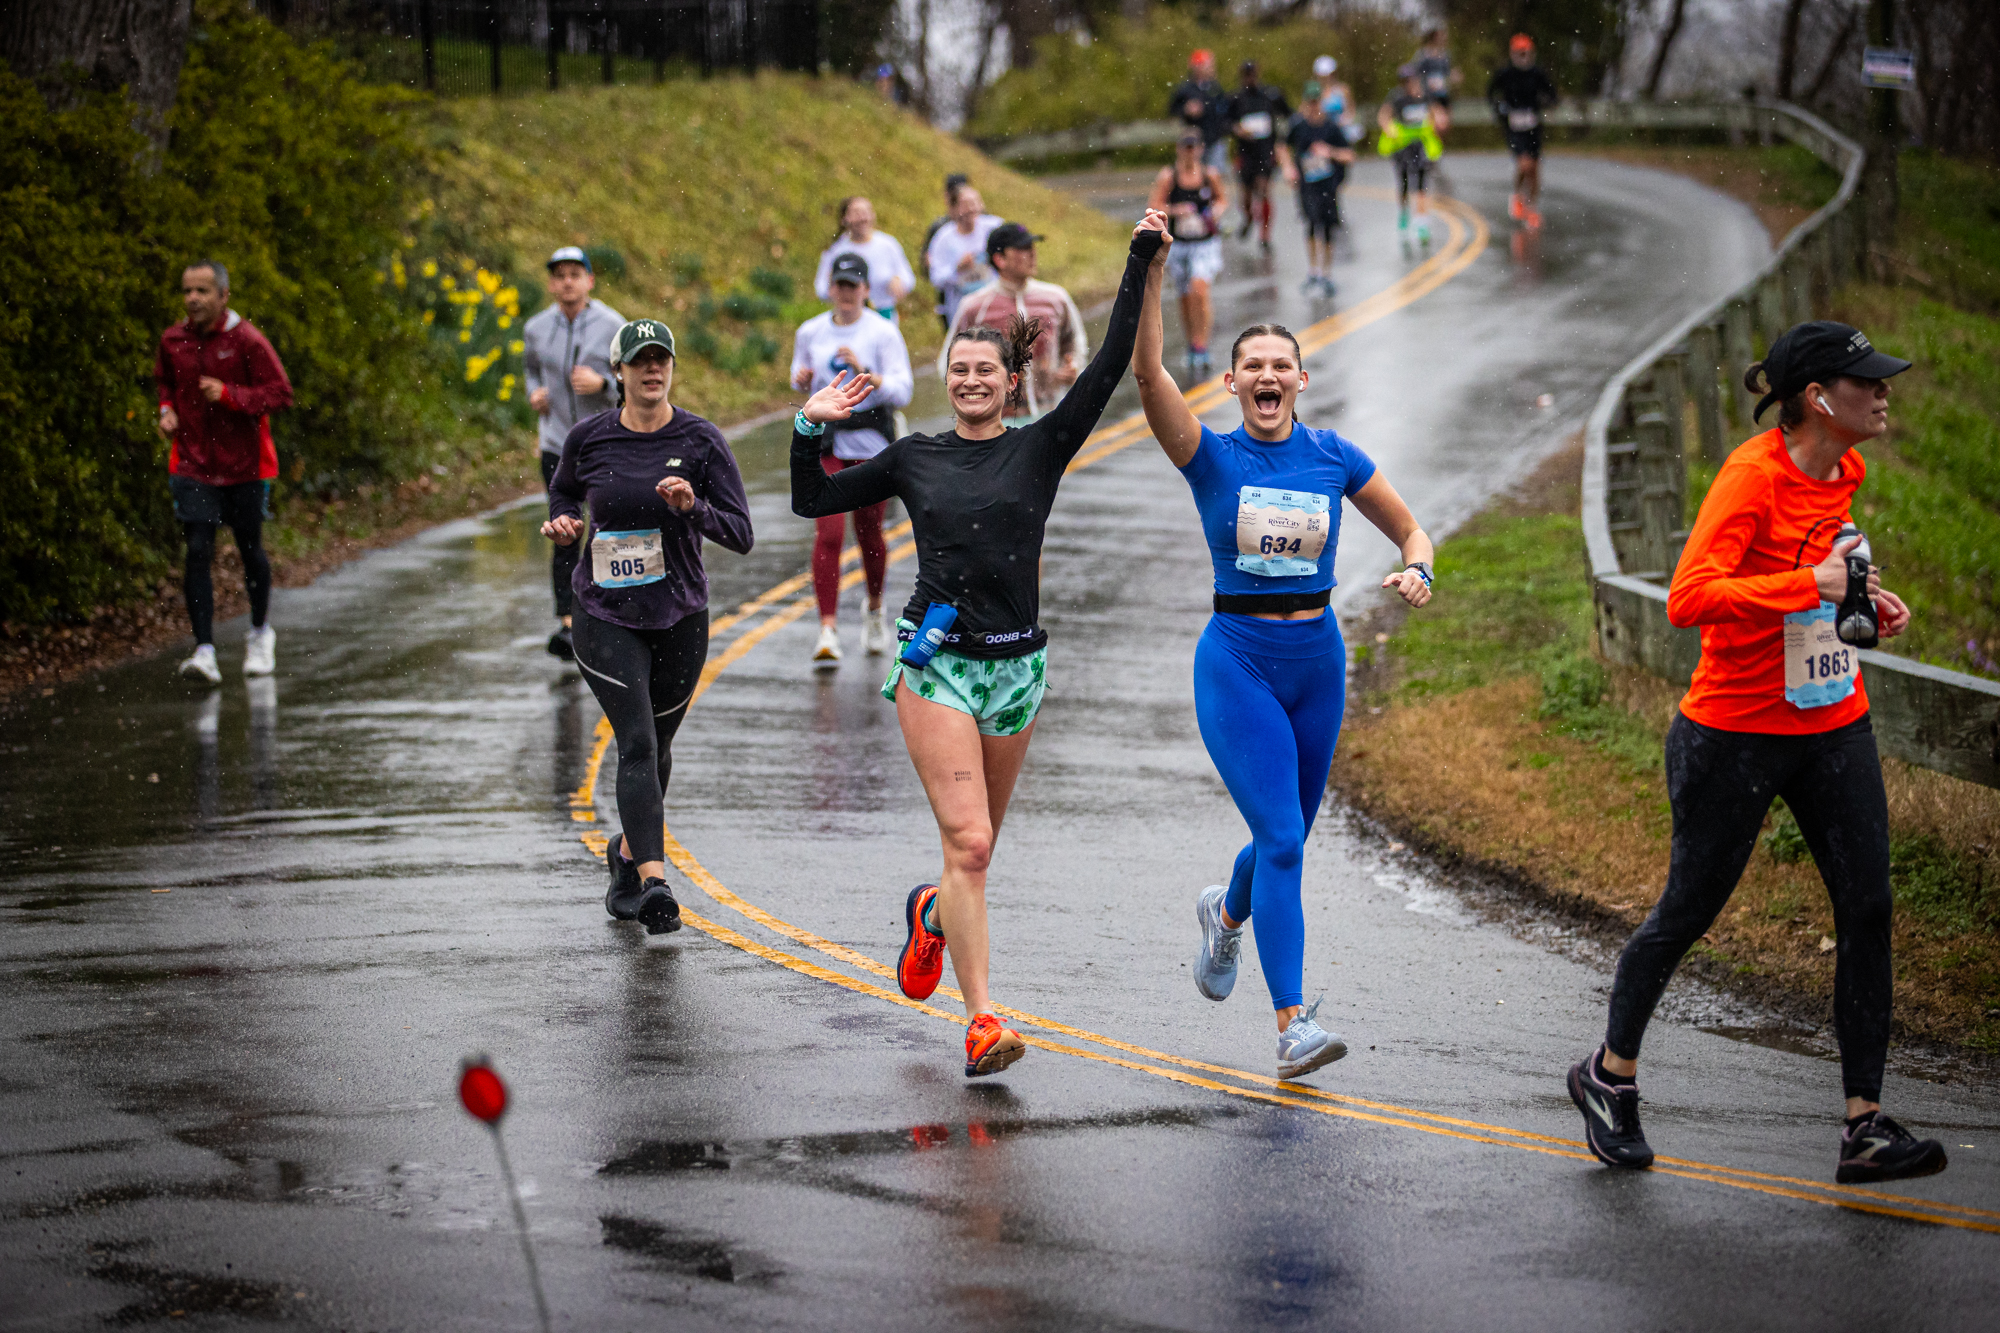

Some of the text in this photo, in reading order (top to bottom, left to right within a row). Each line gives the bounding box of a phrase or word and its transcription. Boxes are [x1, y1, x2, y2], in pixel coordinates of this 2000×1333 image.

[636, 322, 656, 339] NY
[1268, 518, 1285, 527] River
[1286, 520, 1301, 529] City
[1260, 535, 1302, 555] 634
[610, 558, 645, 577] 805
[1805, 648, 1850, 680] 1863
